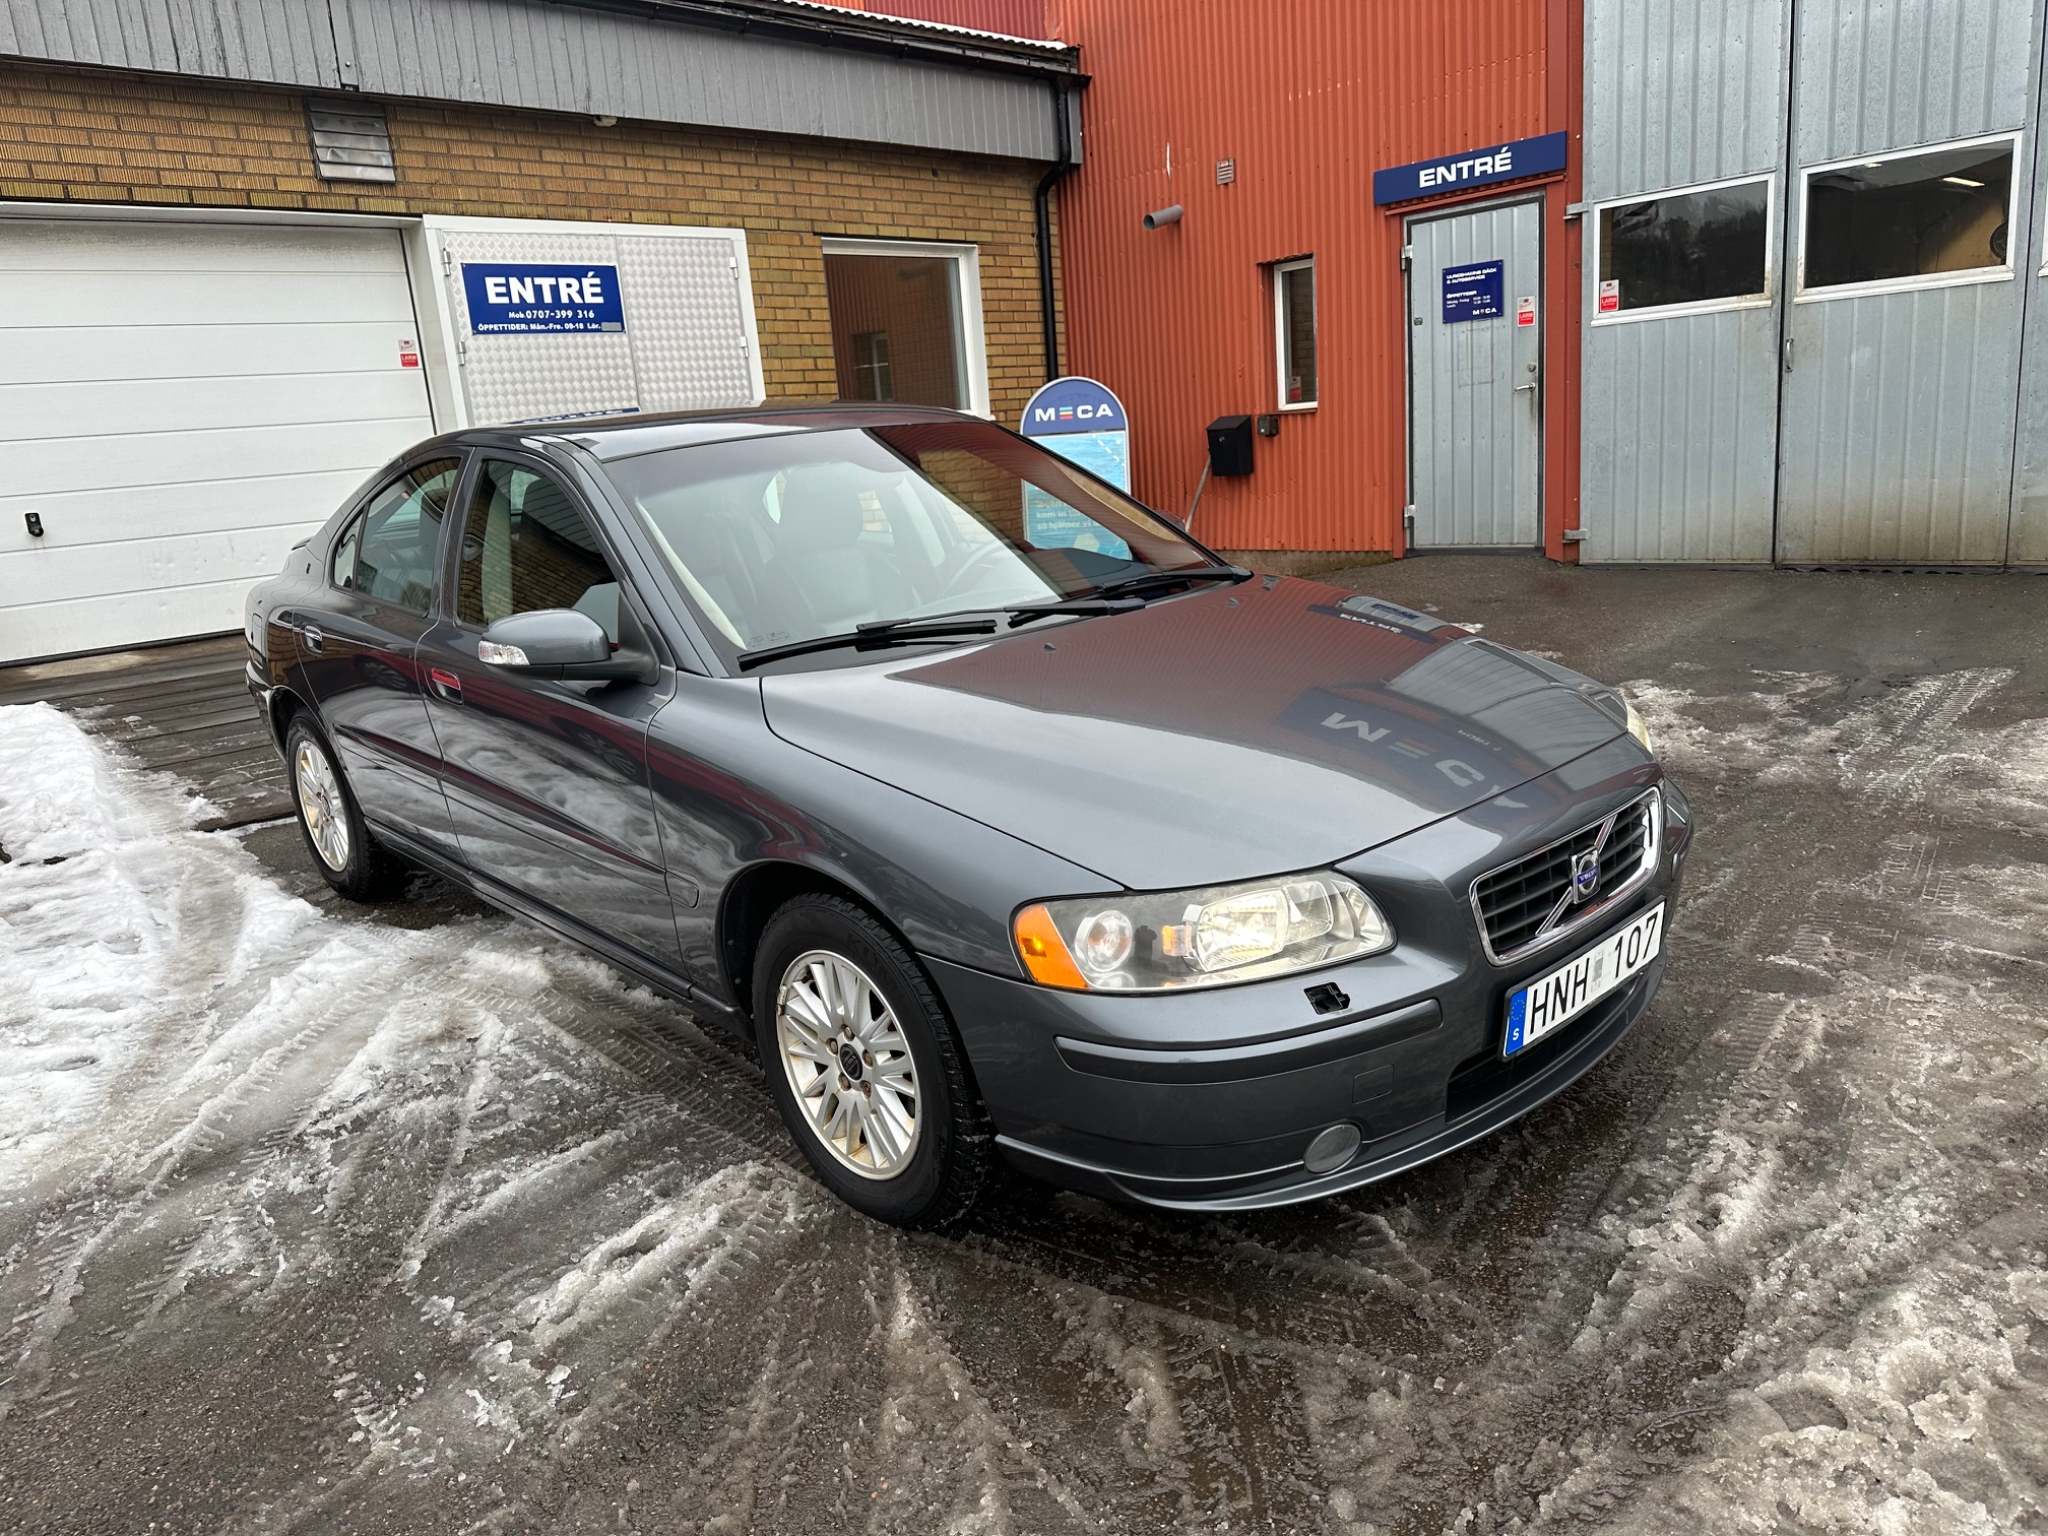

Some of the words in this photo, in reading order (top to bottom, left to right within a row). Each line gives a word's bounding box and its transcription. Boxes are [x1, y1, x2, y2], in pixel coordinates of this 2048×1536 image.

[1419, 146, 1512, 188] ENTRÉ
[484, 271, 604, 304] ENTRÉ
[576, 309, 595, 318] 316
[478, 322, 528, 331] ÖPPETTIDER:
[1035, 403, 1114, 422] MECA
[1530, 957, 1590, 1035] HNH
[1614, 911, 1658, 979] 107
[1512, 1027, 1519, 1041] S
